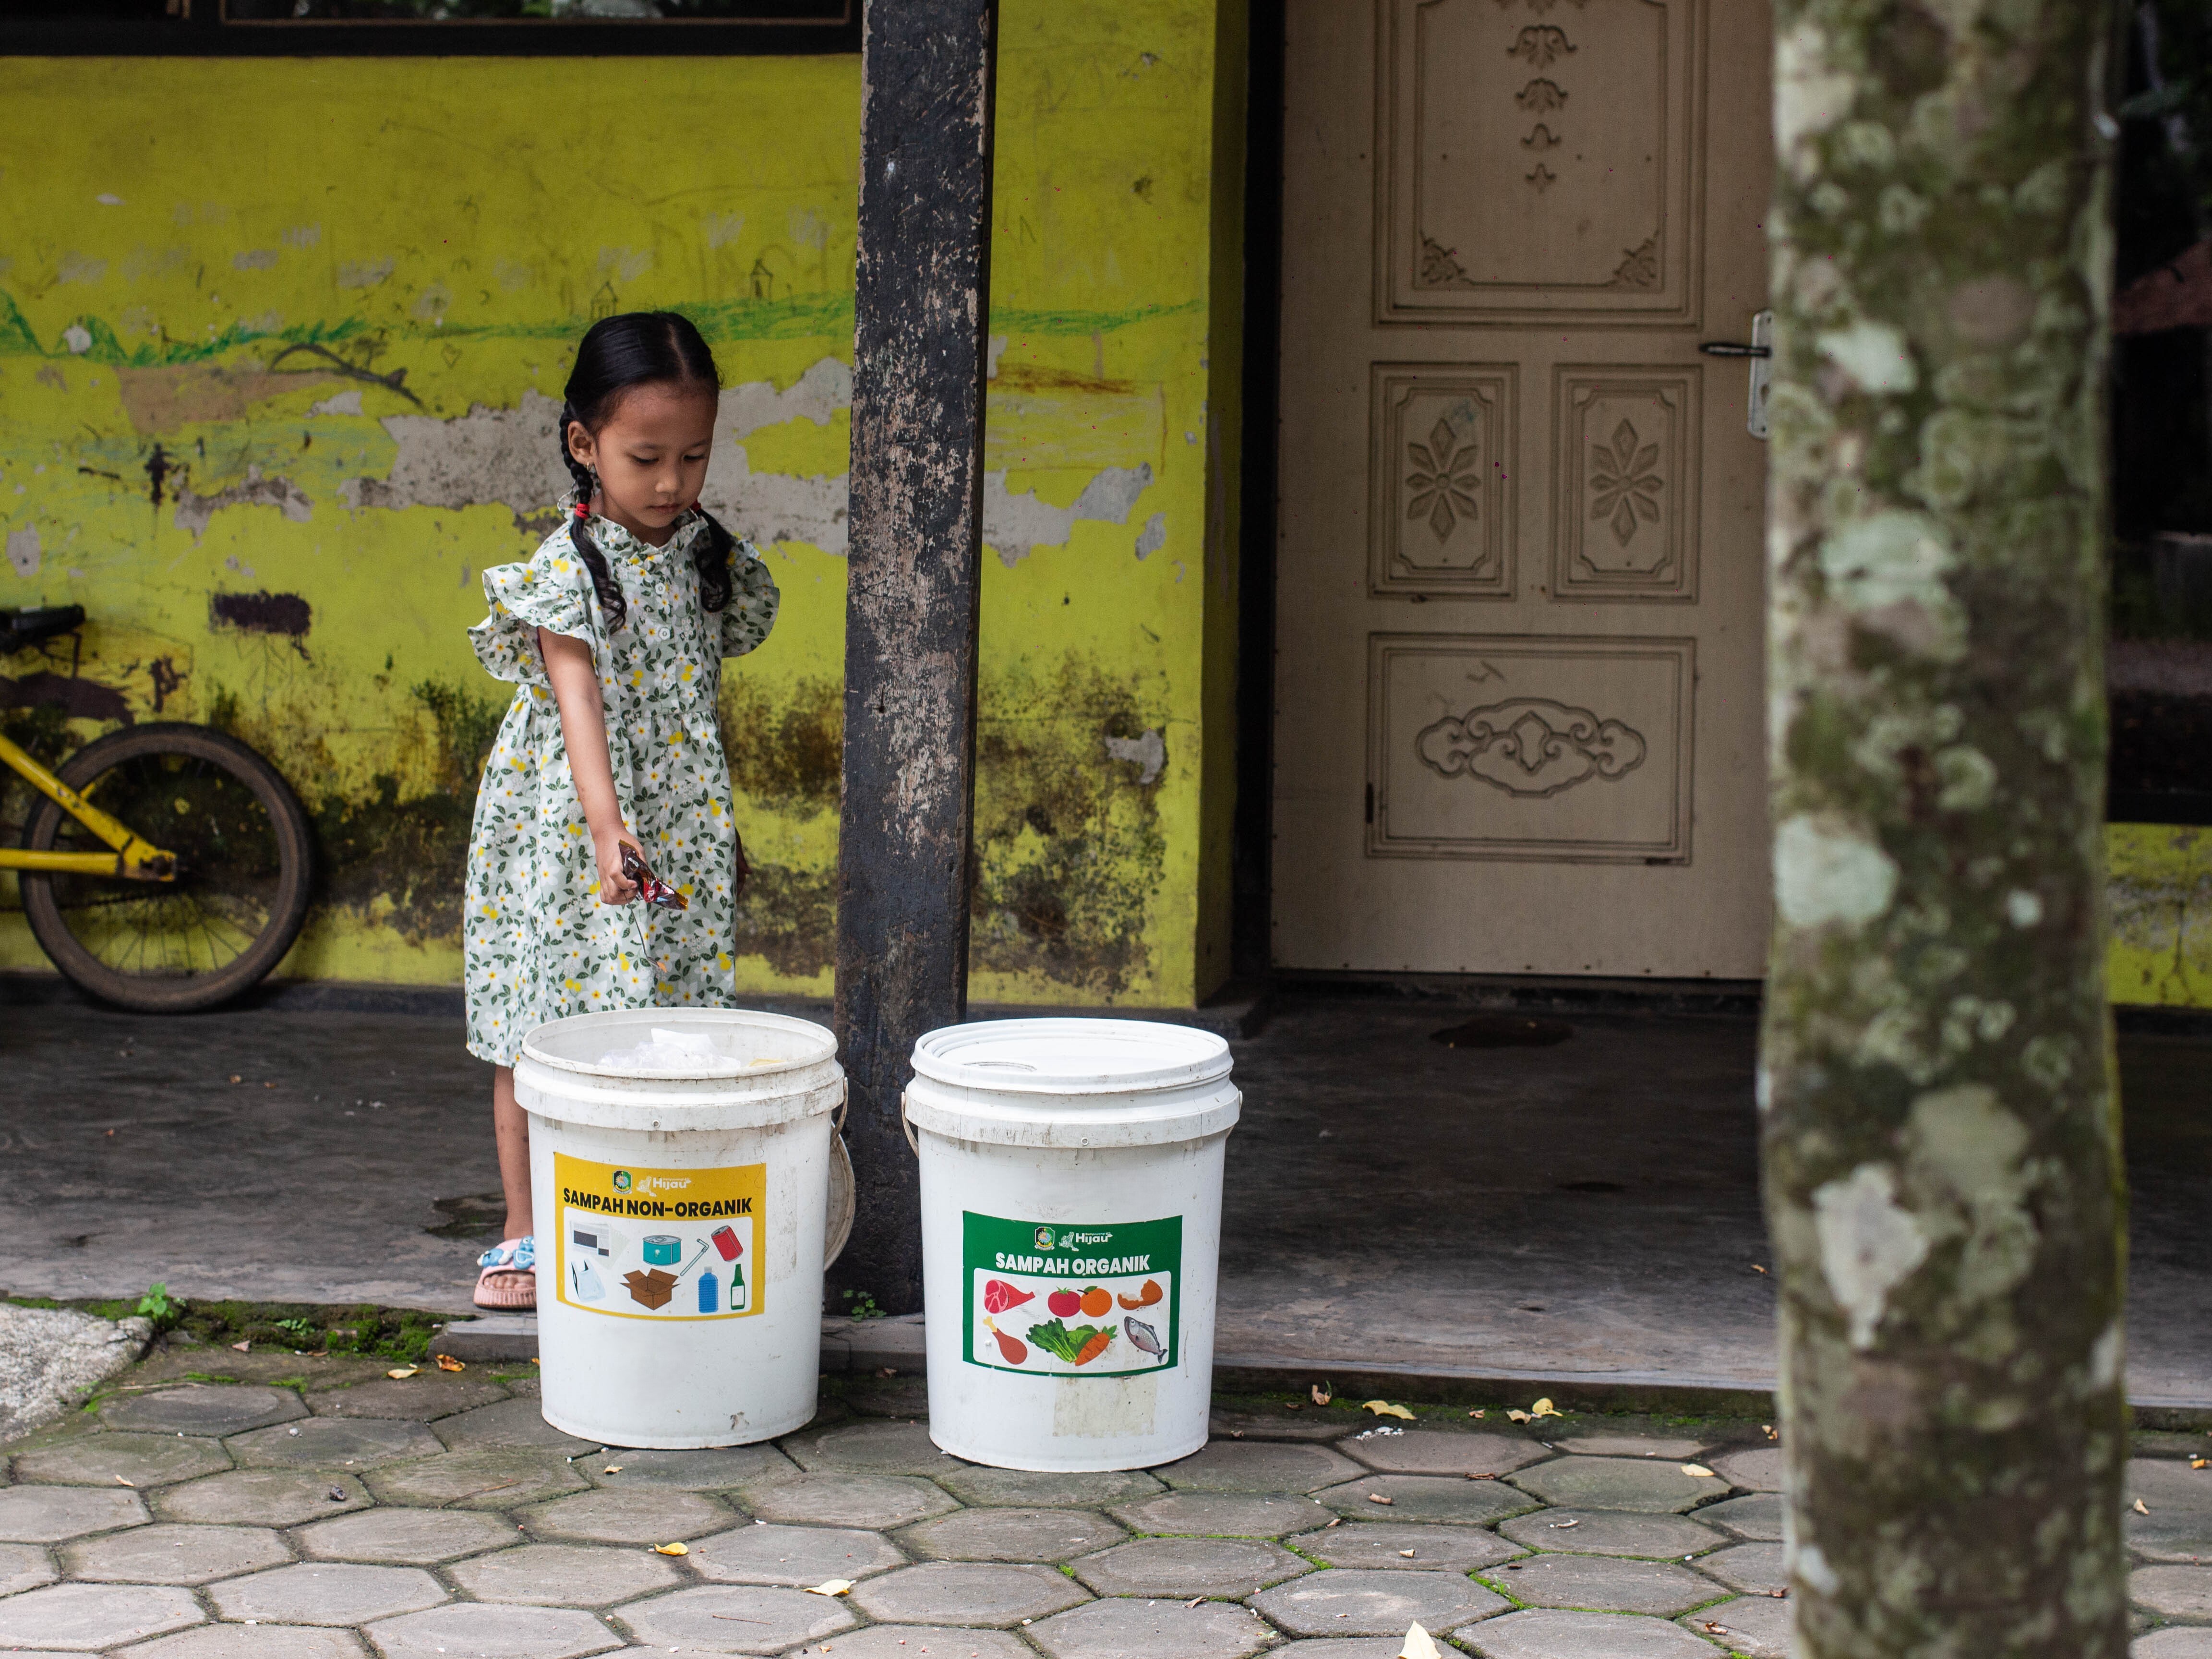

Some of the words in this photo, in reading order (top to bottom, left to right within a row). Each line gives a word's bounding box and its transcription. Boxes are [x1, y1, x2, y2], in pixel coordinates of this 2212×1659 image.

[653, 1178, 686, 1190] Hijau
[564, 1188, 623, 1214] SAMPAH
[627, 1197, 752, 1217] NON-ORGANIK
[1075, 1233, 1108, 1244] Hijau
[996, 1252, 1069, 1274] SAMPAH
[1072, 1254, 1150, 1274] ORGANIK
